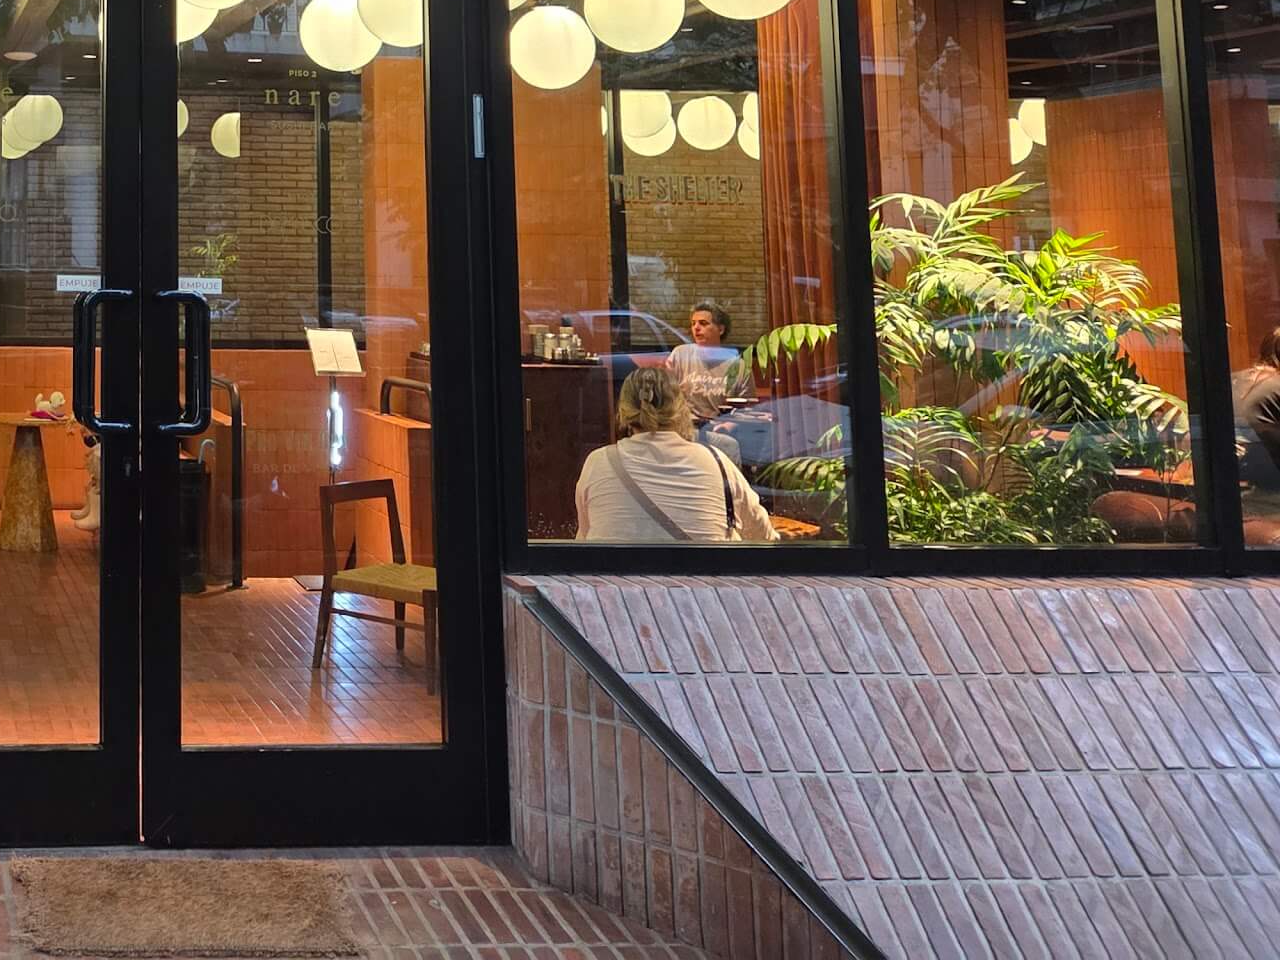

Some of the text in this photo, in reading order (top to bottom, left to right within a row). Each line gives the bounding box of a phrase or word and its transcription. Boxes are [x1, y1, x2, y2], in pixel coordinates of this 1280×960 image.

[288, 69, 318, 78] PISO 2
[264, 88, 342, 107] nare
[608, 173, 744, 206] THE SHELTER
[58, 278, 99, 288] EMPUJE
[180, 281, 220, 291] EMPUJE
